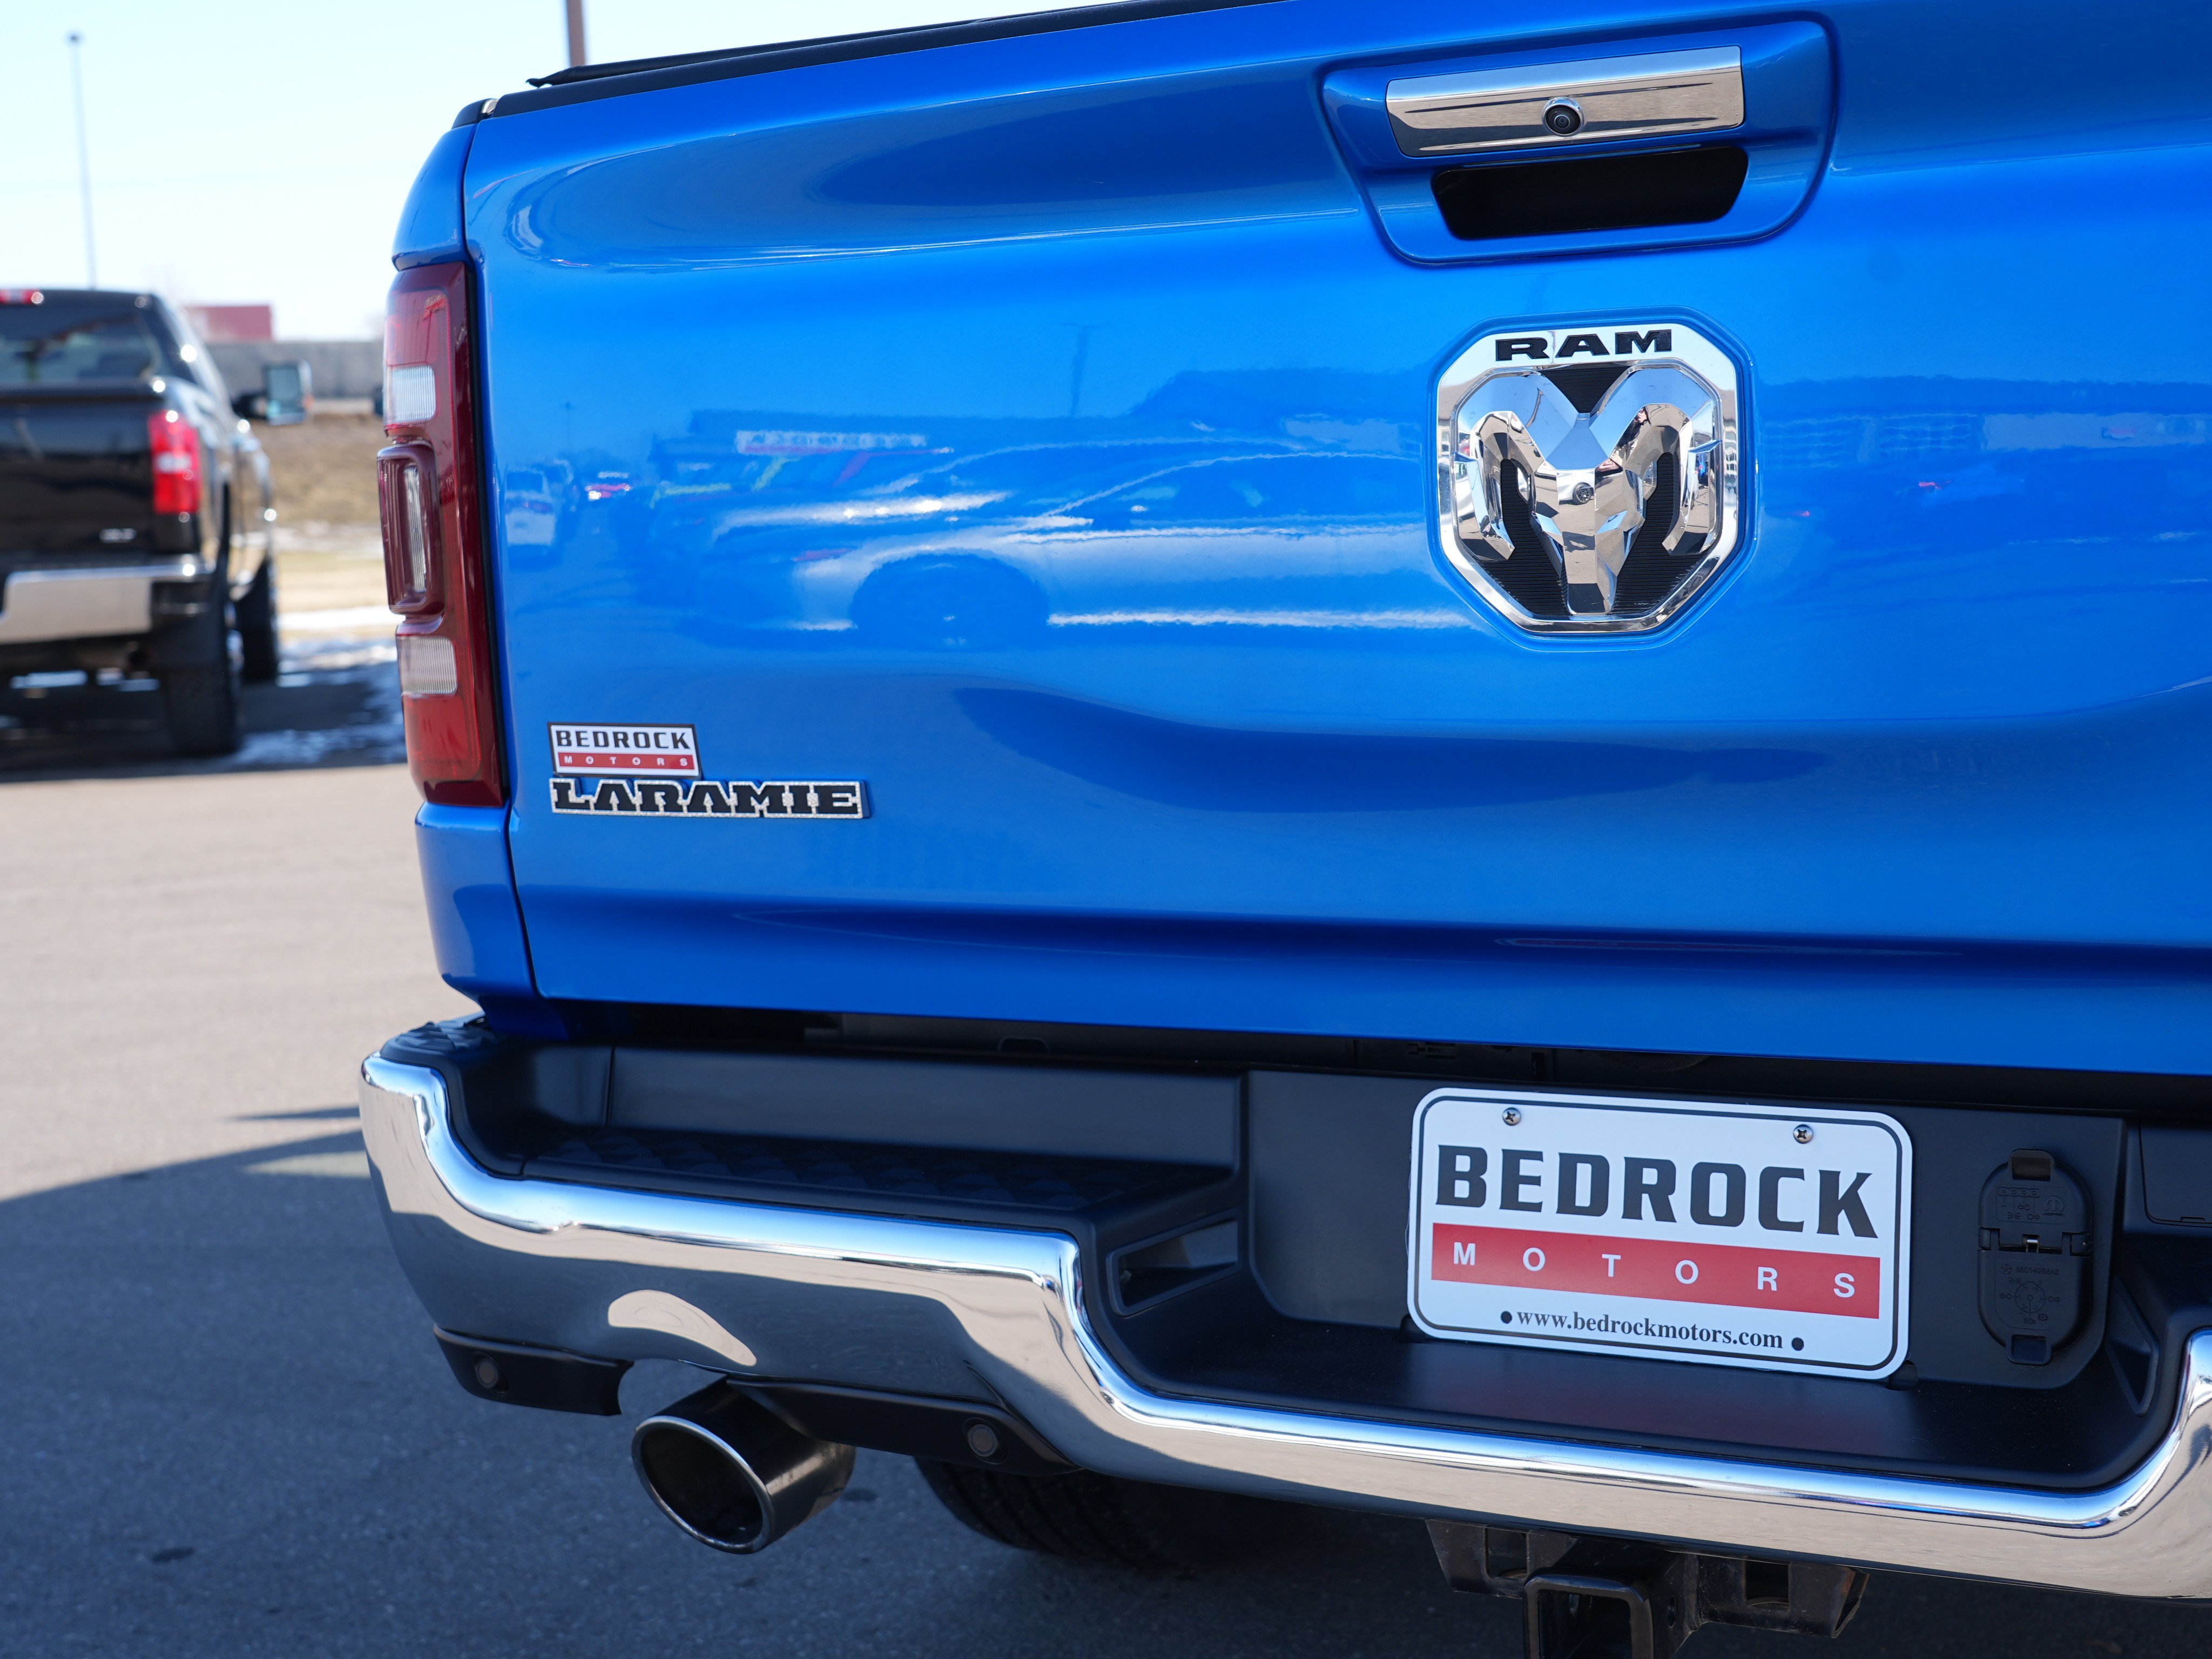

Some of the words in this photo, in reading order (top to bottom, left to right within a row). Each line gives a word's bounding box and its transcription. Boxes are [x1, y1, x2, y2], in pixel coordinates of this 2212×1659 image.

[1495, 330, 1671, 361] RAM
[556, 731, 691, 749] BEDROCK
[564, 756, 688, 766] MOTORS
[550, 778, 863, 819] LARAMIE
[1435, 1145, 1878, 1238] BEDROCK
[1453, 1242, 1856, 1298] MOTORS
[1516, 1311, 1783, 1349] www.bedrockmotors.com
